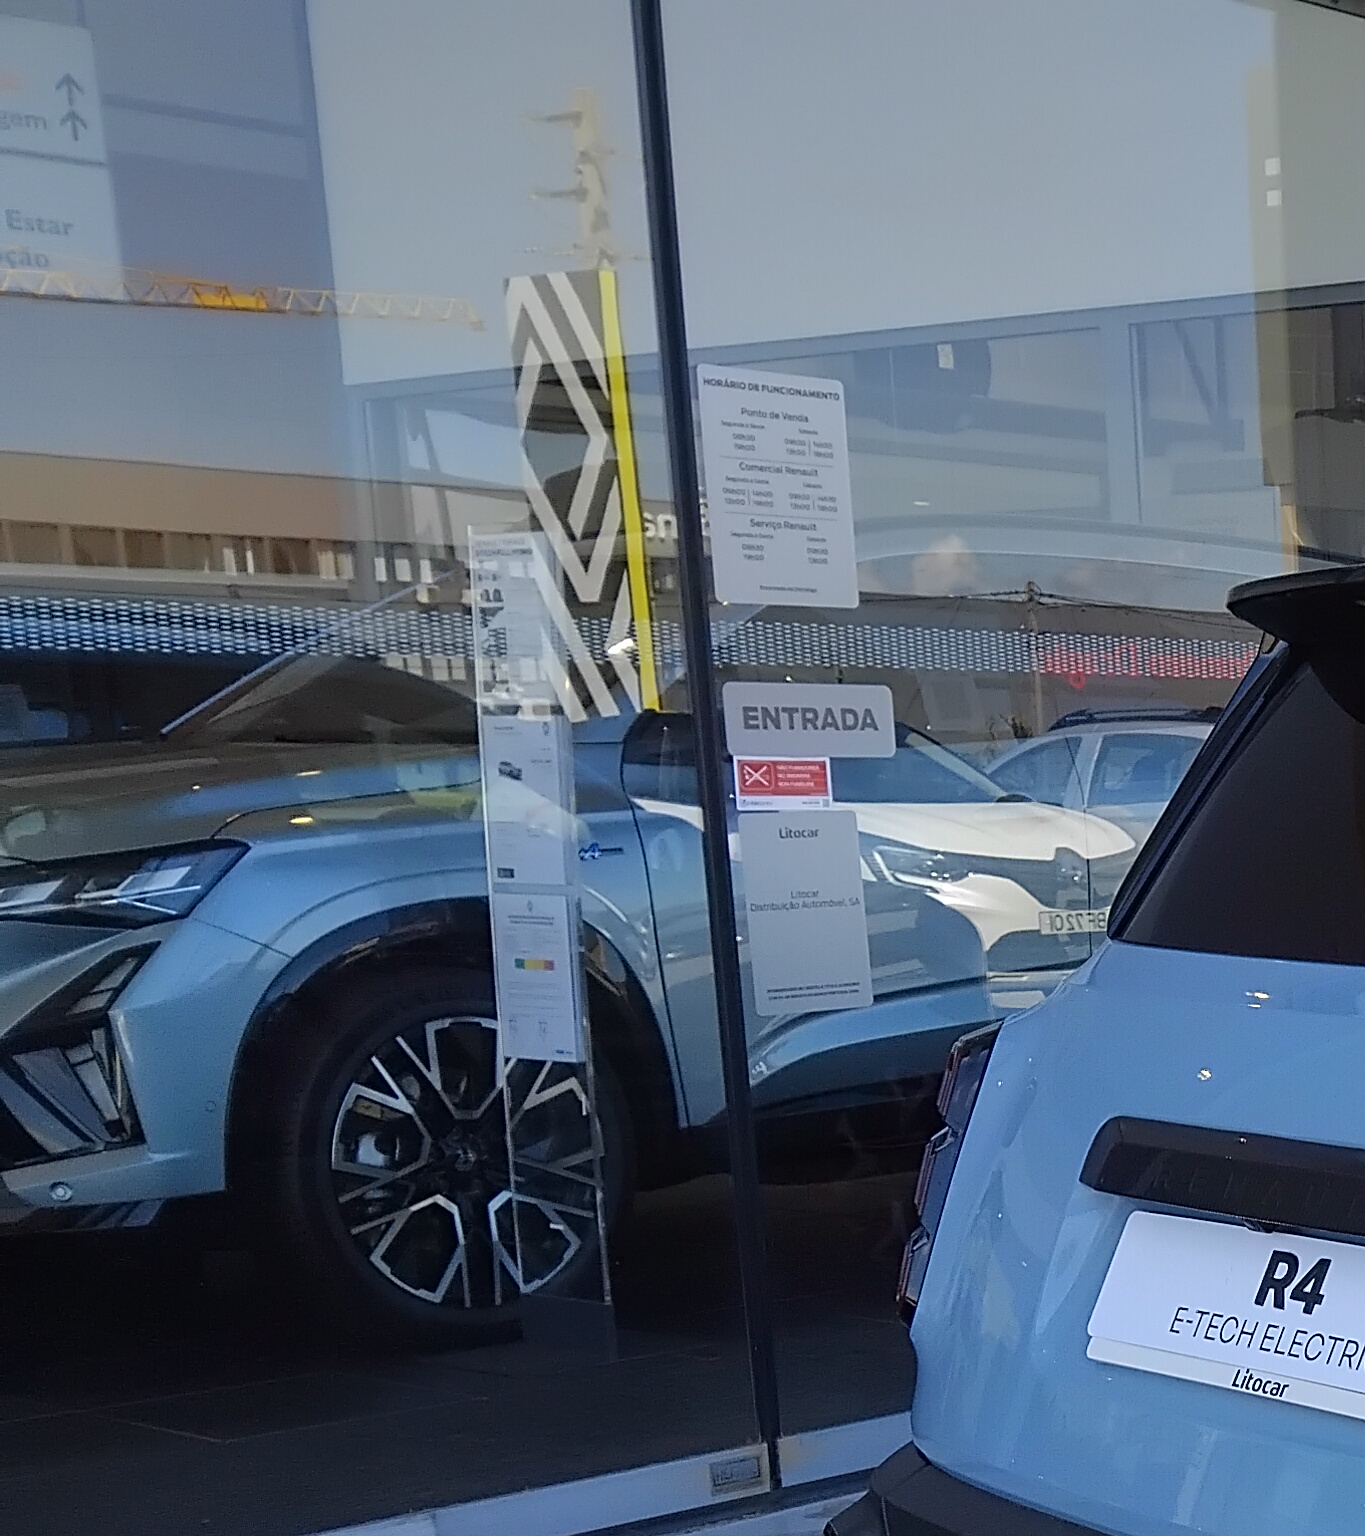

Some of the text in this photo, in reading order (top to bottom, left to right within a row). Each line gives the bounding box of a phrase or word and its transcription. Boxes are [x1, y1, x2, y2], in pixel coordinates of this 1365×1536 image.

[703, 376, 840, 401] HORÁRIO DE FUNCIONAMENTO
[769, 410, 780, 420] de
[782, 412, 809, 423] Venda
[739, 461, 818, 477] Comercial Renault
[750, 519, 817, 532] Serviço Renault
[742, 706, 879, 731] ENTRADA
[779, 827, 819, 839] Litocar
[791, 889, 819, 900] Litocar
[750, 897, 861, 912] Distribuição Automóvel, SA
[1254, 1249, 1332, 1315] R4
[1169, 1306, 1259, 1349] E-TECH
[1231, 1368, 1290, 1399] Litocar
